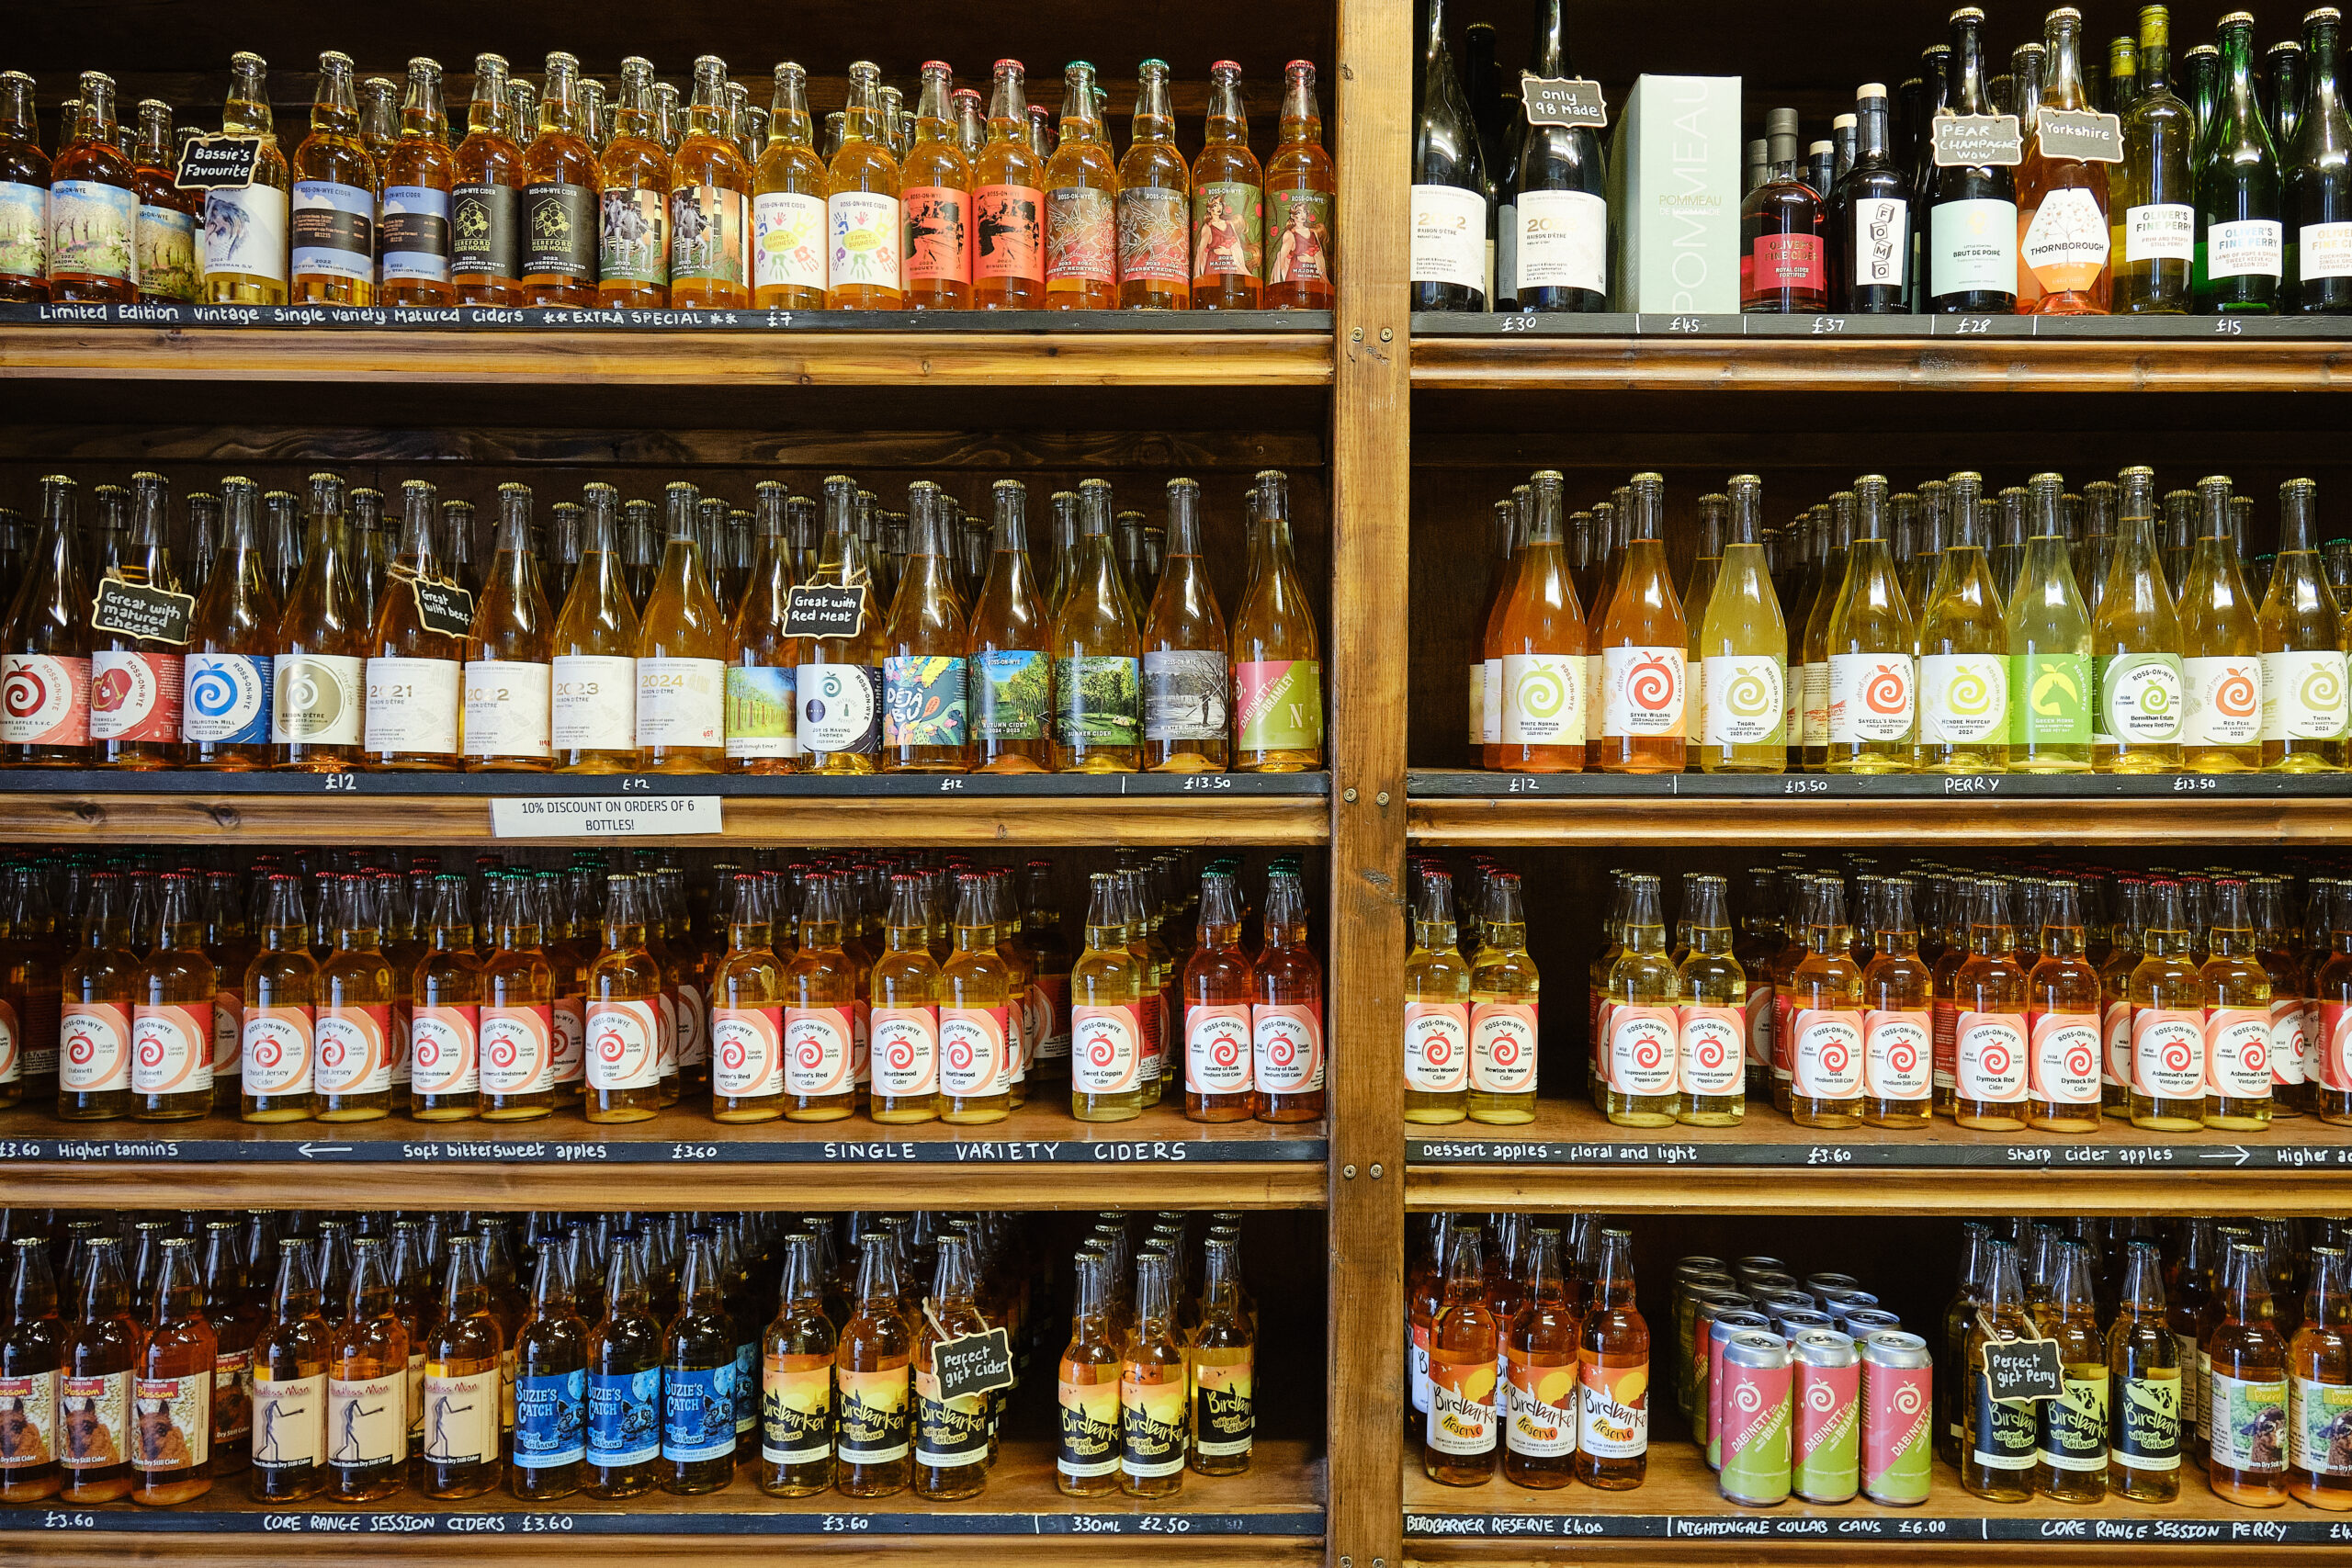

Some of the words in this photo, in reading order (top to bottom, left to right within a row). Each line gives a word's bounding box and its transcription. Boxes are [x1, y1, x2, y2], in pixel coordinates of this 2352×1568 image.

[1536, 102, 1556, 115] 98
[1942, 125, 1989, 137] PEAR
[2045, 122, 2109, 140] Yorkshire
[1940, 140, 2018, 150] CHAMPAGNE
[195, 147, 250, 162] Bassie's
[186, 164, 250, 177] Favourite
[1659, 195, 1722, 206] POMMEAU
[2225, 228, 2273, 238] OLIVER'S
[2031, 242, 2104, 255] THORNBOROUGH
[2220, 240, 2242, 250] FINE
[2249, 239, 2277, 248] PERRY
[40, 305, 107, 320] Limited
[119, 305, 178, 321] Edition
[275, 308, 327, 324] Single
[395, 310, 459, 323] Matured
[472, 310, 524, 323] Ciders
[573, 313, 624, 323] EXTRA
[632, 312, 702, 324] SPECIAL
[766, 312, 792, 327] £7
[1501, 318, 1537, 331] £30
[1669, 318, 1700, 331] £45
[1812, 318, 1845, 333] £37
[1956, 319, 1991, 333] £28
[2215, 320, 2242, 334] £15
[107, 592, 146, 610] Great
[150, 604, 180, 619] with
[421, 590, 448, 605] Great
[795, 596, 828, 607] Great
[831, 597, 856, 608] with
[104, 604, 168, 627] matured
[424, 603, 445, 615] with
[448, 605, 469, 626] beef
[791, 611, 816, 621] Red
[820, 611, 853, 623] Meat
[104, 616, 159, 636] cheese
[641, 674, 684, 689] 2024
[887, 687, 923, 707] DÉJÀ
[1264, 673, 1294, 713] BRAMLEY
[1240, 683, 1271, 729] DABINETT
[325, 773, 356, 790] £12
[941, 778, 963, 791] £12
[1183, 776, 1231, 790] £13.50
[1509, 778, 1539, 792] £12
[1945, 777, 2000, 795] PERRY
[2174, 778, 2216, 790] £13.50
[522, 801, 544, 813] 10%
[548, 801, 601, 813] DISCOUNT
[605, 801, 621, 813] ON
[625, 800, 667, 813] ORDERS
[671, 800, 684, 812] OF
[687, 799, 694, 812] 6
[585, 818, 634, 831] BOTTLES!
[884, 1069, 917, 1077] Northwood
[1083, 1069, 1099, 1077] Sweet
[1101, 1069, 1123, 1078] Coppin
[1976, 1075, 2002, 1084] Dymock
[0, 1145, 40, 1157] £3.60
[59, 1144, 109, 1160] Higher
[114, 1142, 179, 1156] tannins
[403, 1144, 439, 1157] Soft
[447, 1142, 545, 1158] bittersweet
[556, 1144, 606, 1160] apples
[824, 1143, 916, 1158] SINGLE
[955, 1143, 1059, 1160] VARIETY
[1094, 1142, 1186, 1160] CIDERS
[1423, 1145, 1485, 1157] Dessert
[1494, 1145, 1547, 1158] apples
[1570, 1145, 1611, 1159] floral
[1619, 1146, 1648, 1159] and
[1657, 1145, 1698, 1163] light
[1807, 1147, 1851, 1163] £3.60
[2007, 1148, 2052, 1164] Sharp
[2065, 1148, 2110, 1161] cider
[2119, 1147, 2173, 1162] apples
[2277, 1147, 2328, 1166] Higher
[944, 1346, 990, 1368] Perfect
[1993, 1354, 2041, 1371] Perfect
[945, 1369, 970, 1387] gift
[1997, 1370, 2022, 1388] gift
[63, 1380, 99, 1396] Blossom
[516, 1381, 557, 1401] SUZIE'S
[2254, 1390, 2281, 1403] Perry
[518, 1404, 553, 1424] CATCH
[763, 1393, 827, 1431] Birdbarker
[1510, 1386, 1575, 1428] Birdbarker
[1518, 1416, 1556, 1440] Reserve
[1837, 1399, 1860, 1441] BRAMLEY
[1804, 1409, 1842, 1453] DABINETT
[45, 1511, 94, 1528] £3.60
[264, 1515, 301, 1530] CORE
[311, 1517, 360, 1531] RANGE
[370, 1516, 435, 1531] SESSION
[447, 1517, 505, 1531] CIDERS
[522, 1517, 573, 1531] £3.60
[823, 1517, 868, 1531] £3.60
[1072, 1517, 1121, 1532] 330ML
[1139, 1517, 1190, 1532] £2.50
[1407, 1516, 1485, 1534] BIRDBARKER
[1492, 1517, 1555, 1534] RESERVE
[1563, 1518, 1604, 1534] £4.00
[1678, 1520, 1770, 1535] NIGHTINGALE
[1777, 1521, 1828, 1533] COLLAB
[1838, 1520, 1883, 1533] CANS
[1898, 1521, 1946, 1533] £6.00
[2041, 1522, 2086, 1537] CORE
[2096, 1521, 2147, 1539] RANGE
[2155, 1521, 2220, 1538] SESSION
[2233, 1522, 2287, 1541] PERRY
